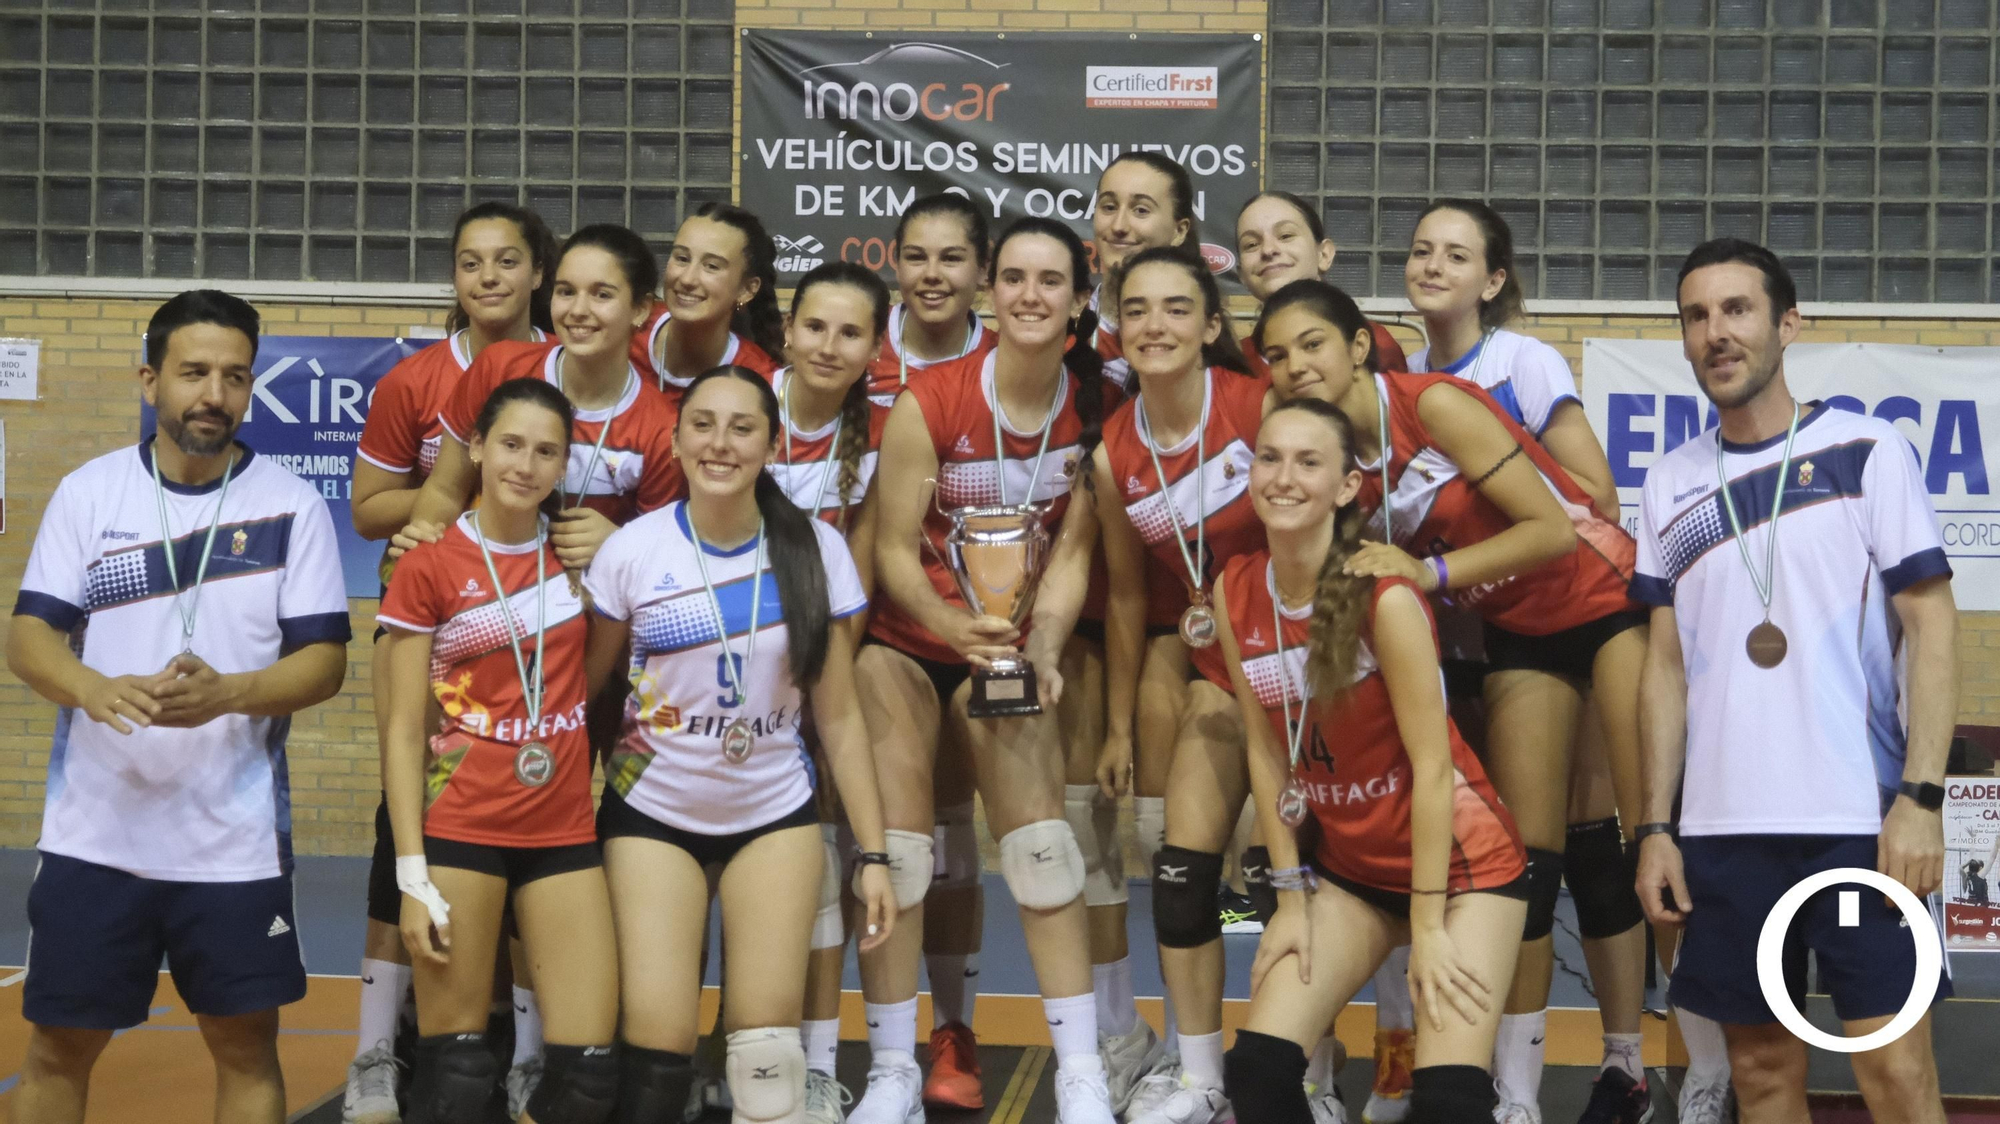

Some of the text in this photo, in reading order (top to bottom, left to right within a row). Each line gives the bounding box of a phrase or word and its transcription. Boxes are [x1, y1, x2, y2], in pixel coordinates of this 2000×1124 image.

[755, 131, 979, 173] VEHÍCULOS
[794, 185, 844, 217] DE
[984, 187, 1011, 218] Y
[314, 431, 363, 442] INTERME
[322, 479, 341, 500] EL
[716, 652, 743, 709] 9
[1948, 784, 2000, 800] CADE
[1982, 809, 2000, 821] CA
